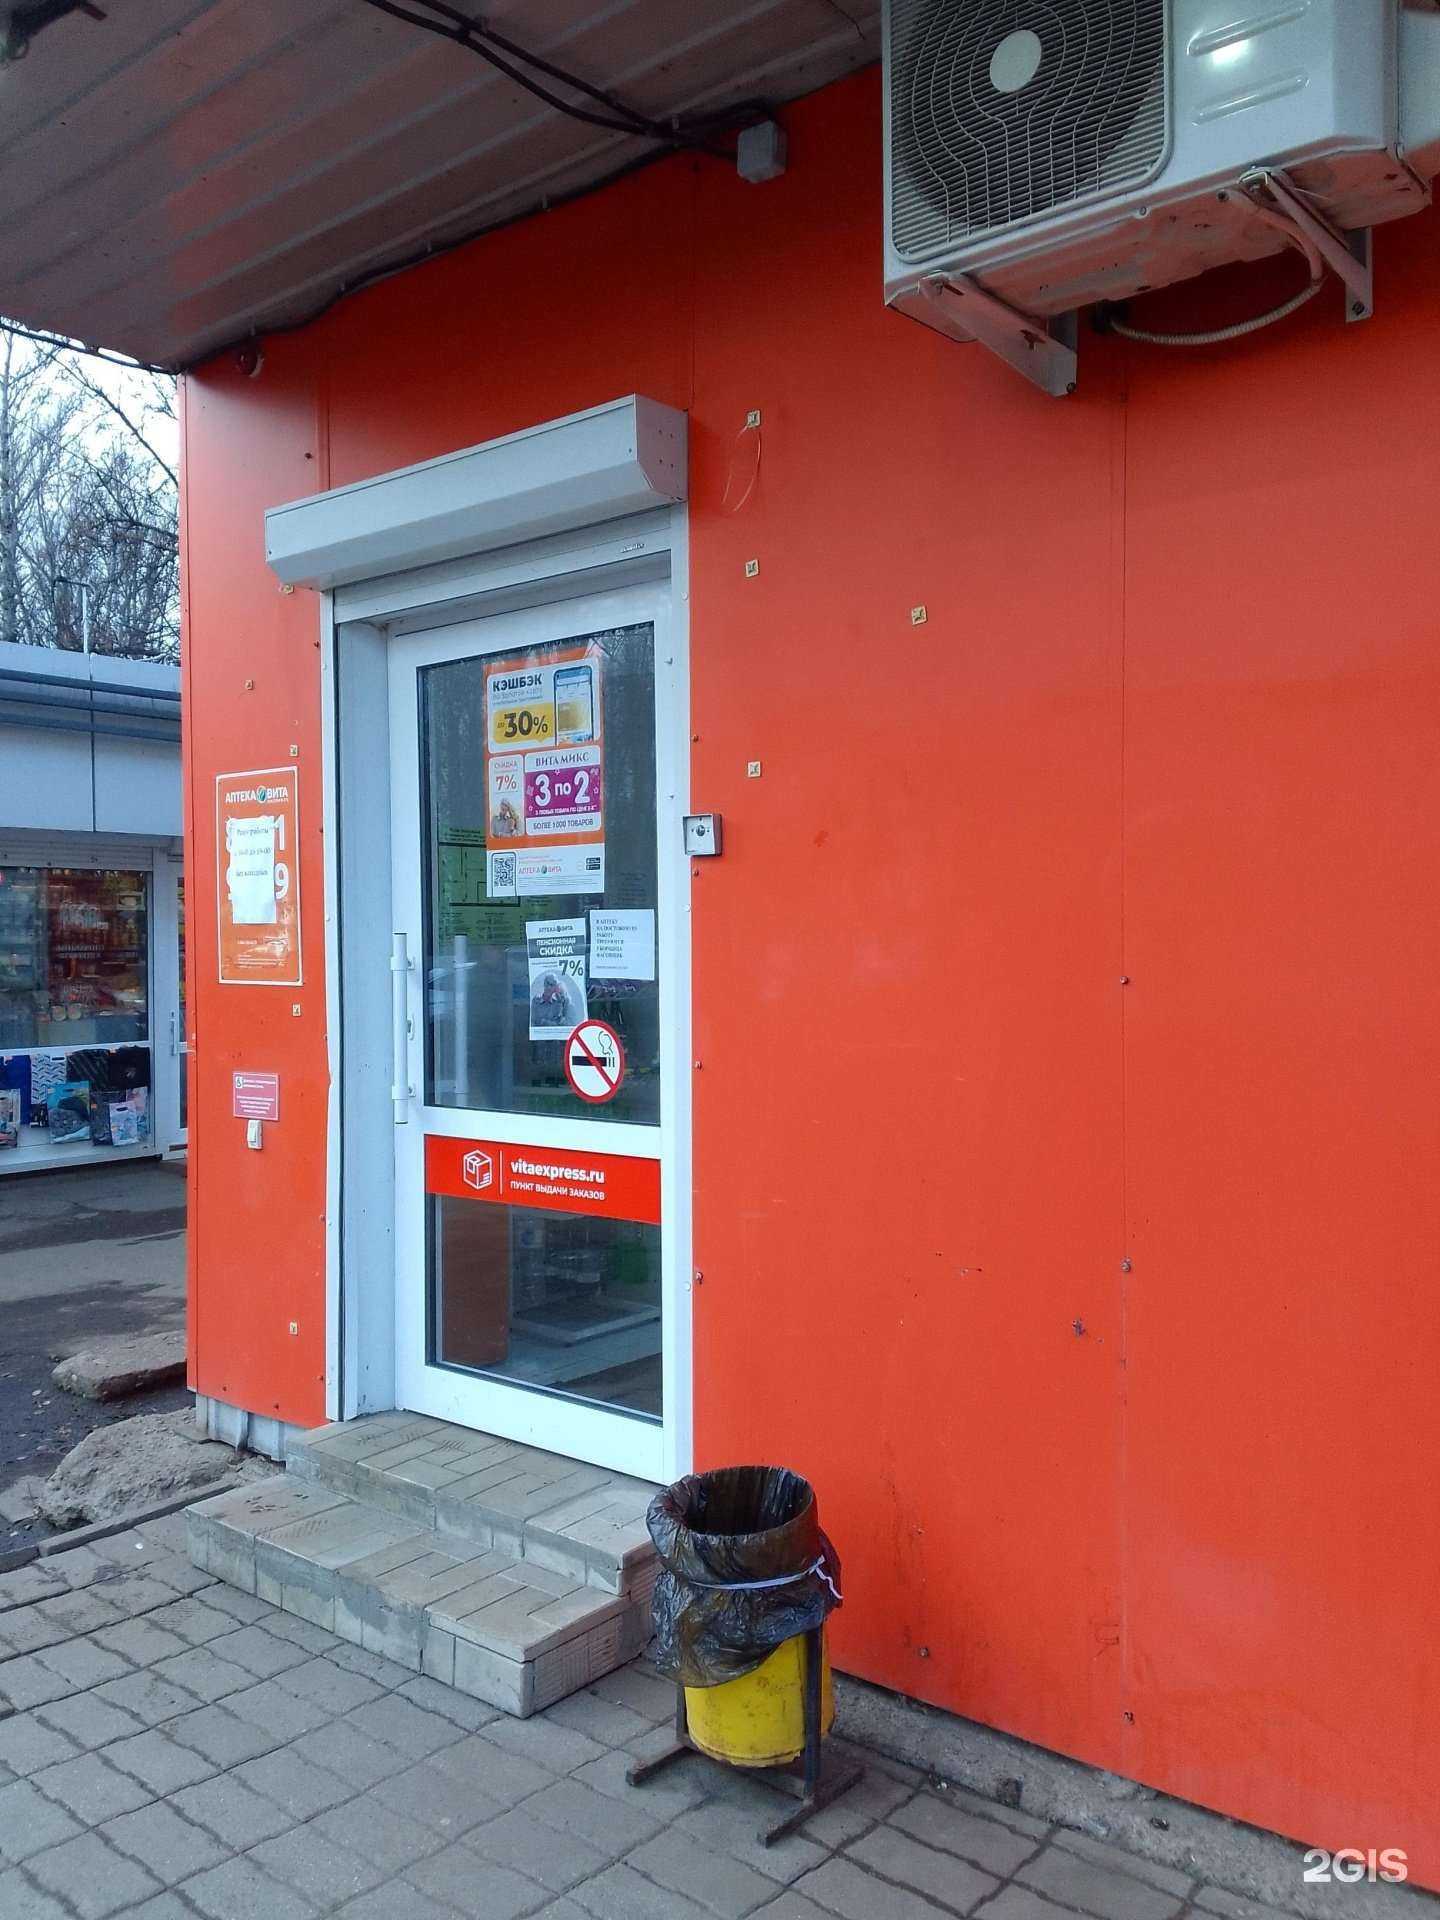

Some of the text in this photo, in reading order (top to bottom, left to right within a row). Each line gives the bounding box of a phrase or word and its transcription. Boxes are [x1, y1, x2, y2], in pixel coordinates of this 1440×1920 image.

[493, 673, 542, 692] КЭШБЭК
[504, 710, 548, 738] 30%
[494, 760, 517, 769] СКИДКА
[535, 752, 590, 767] ВИТАМИКС
[496, 774, 517, 790] 7%
[535, 774, 551, 807] 3
[574, 771, 591, 804] 2
[225, 786, 289, 803] АПТЕКА ВИТА
[568, 818, 593, 827] ТОВАРОВ
[536, 937, 576, 946] ПЕНСИОННАЯ
[540, 945, 574, 957] СКИДКА
[559, 960, 584, 976] 7%
[510, 1158, 605, 1184] vitaexpress.ru
[510, 1180, 605, 1200] ПУНКТ ВЫДАЧИ ЗАКАЗОВ
